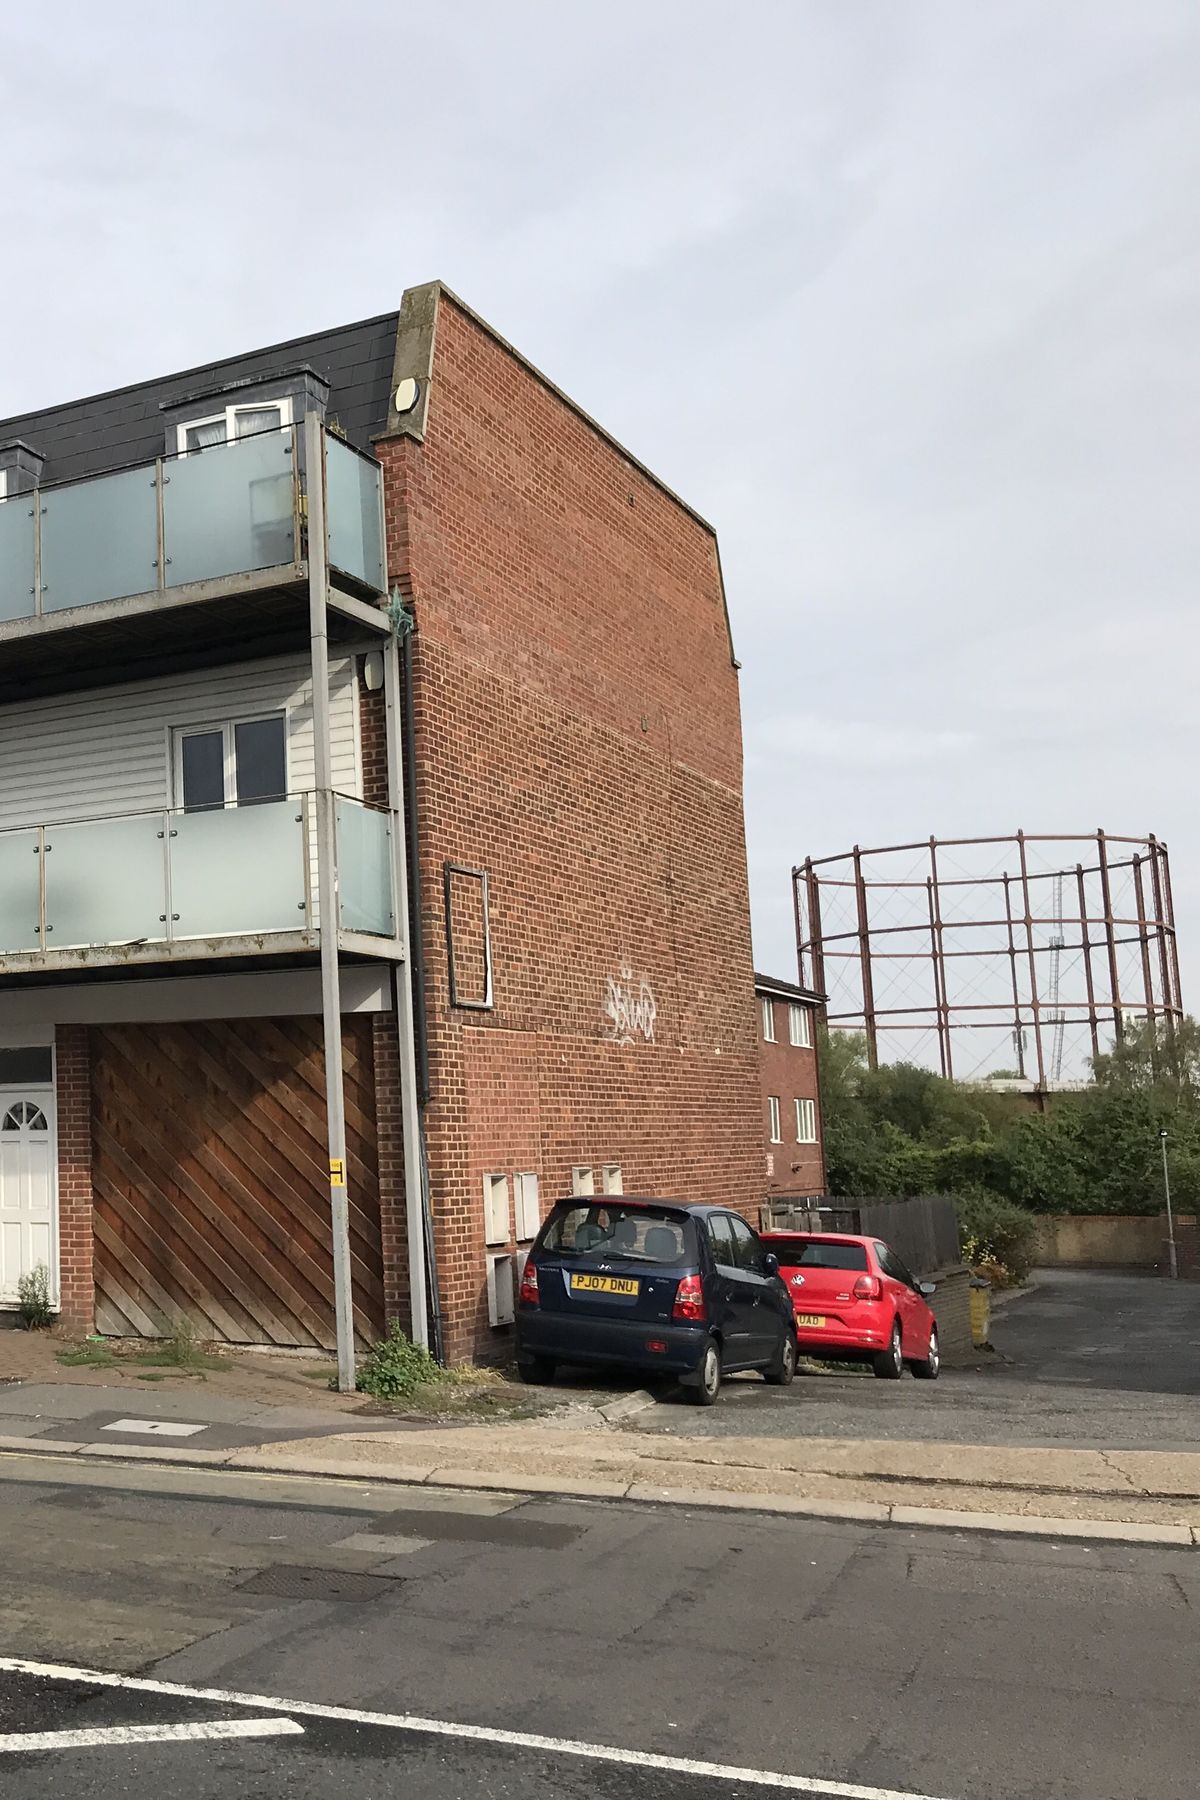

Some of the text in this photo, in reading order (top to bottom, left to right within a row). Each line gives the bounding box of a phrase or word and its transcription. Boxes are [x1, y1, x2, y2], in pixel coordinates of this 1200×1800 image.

[576, 1276, 634, 1293] PJ07 DNU
[799, 1315, 820, 1326] UAD
